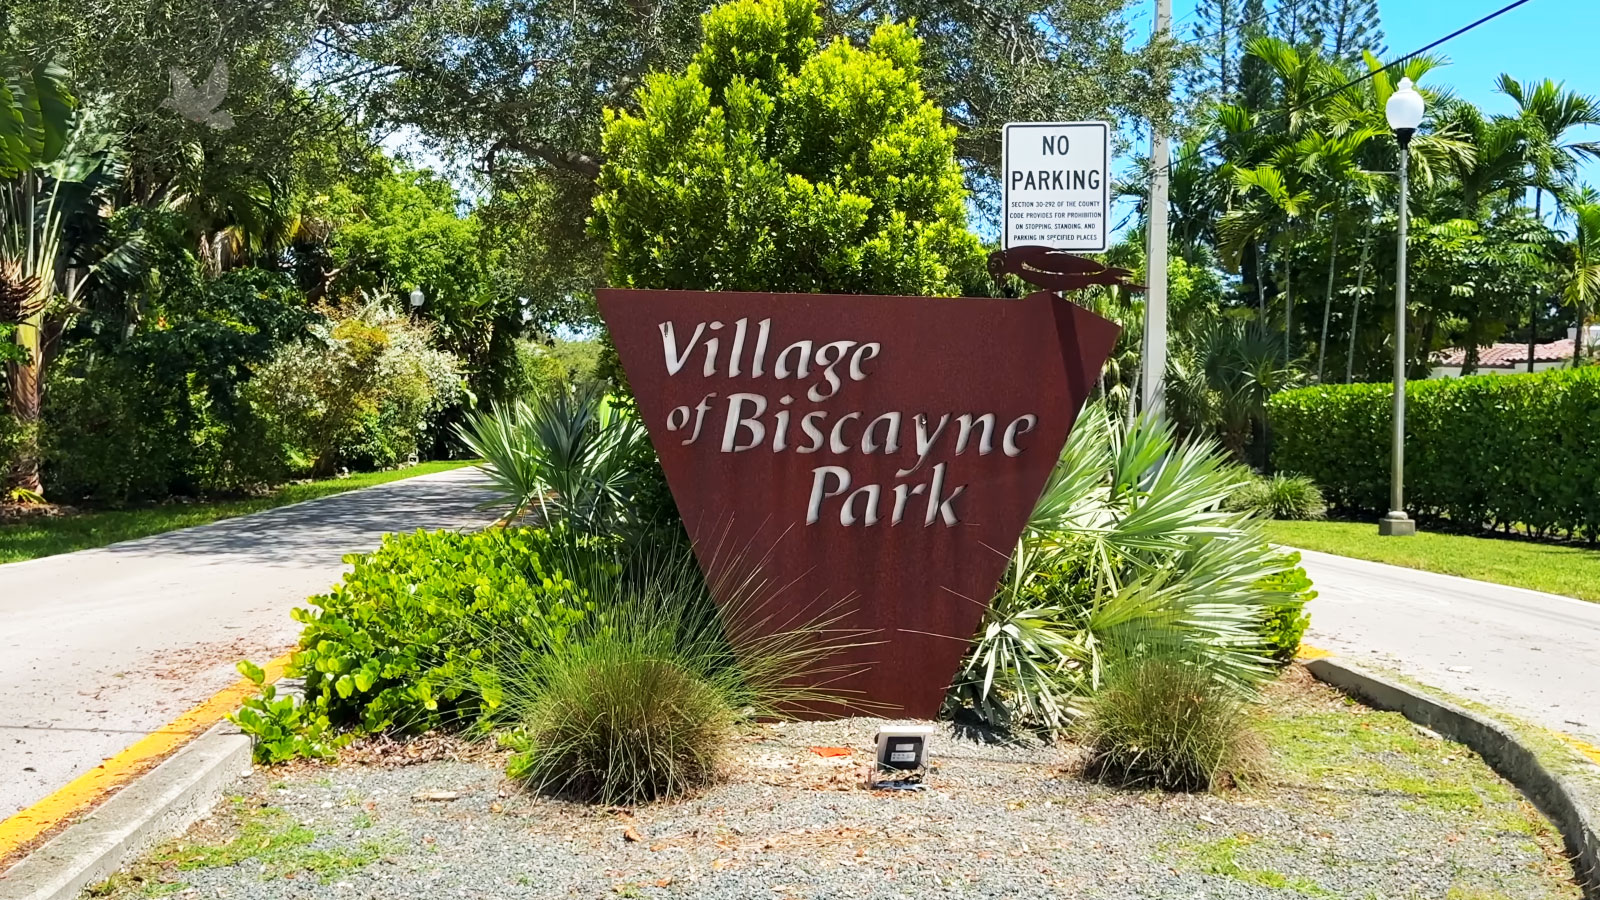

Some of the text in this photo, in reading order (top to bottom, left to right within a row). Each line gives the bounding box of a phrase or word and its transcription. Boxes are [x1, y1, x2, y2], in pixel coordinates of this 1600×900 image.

[1042, 135, 1069, 156] NO
[1012, 169, 1100, 191] PARKING
[658, 317, 881, 403] Village
[666, 391, 1038, 478] of Biscayne
[805, 461, 968, 528] Park
